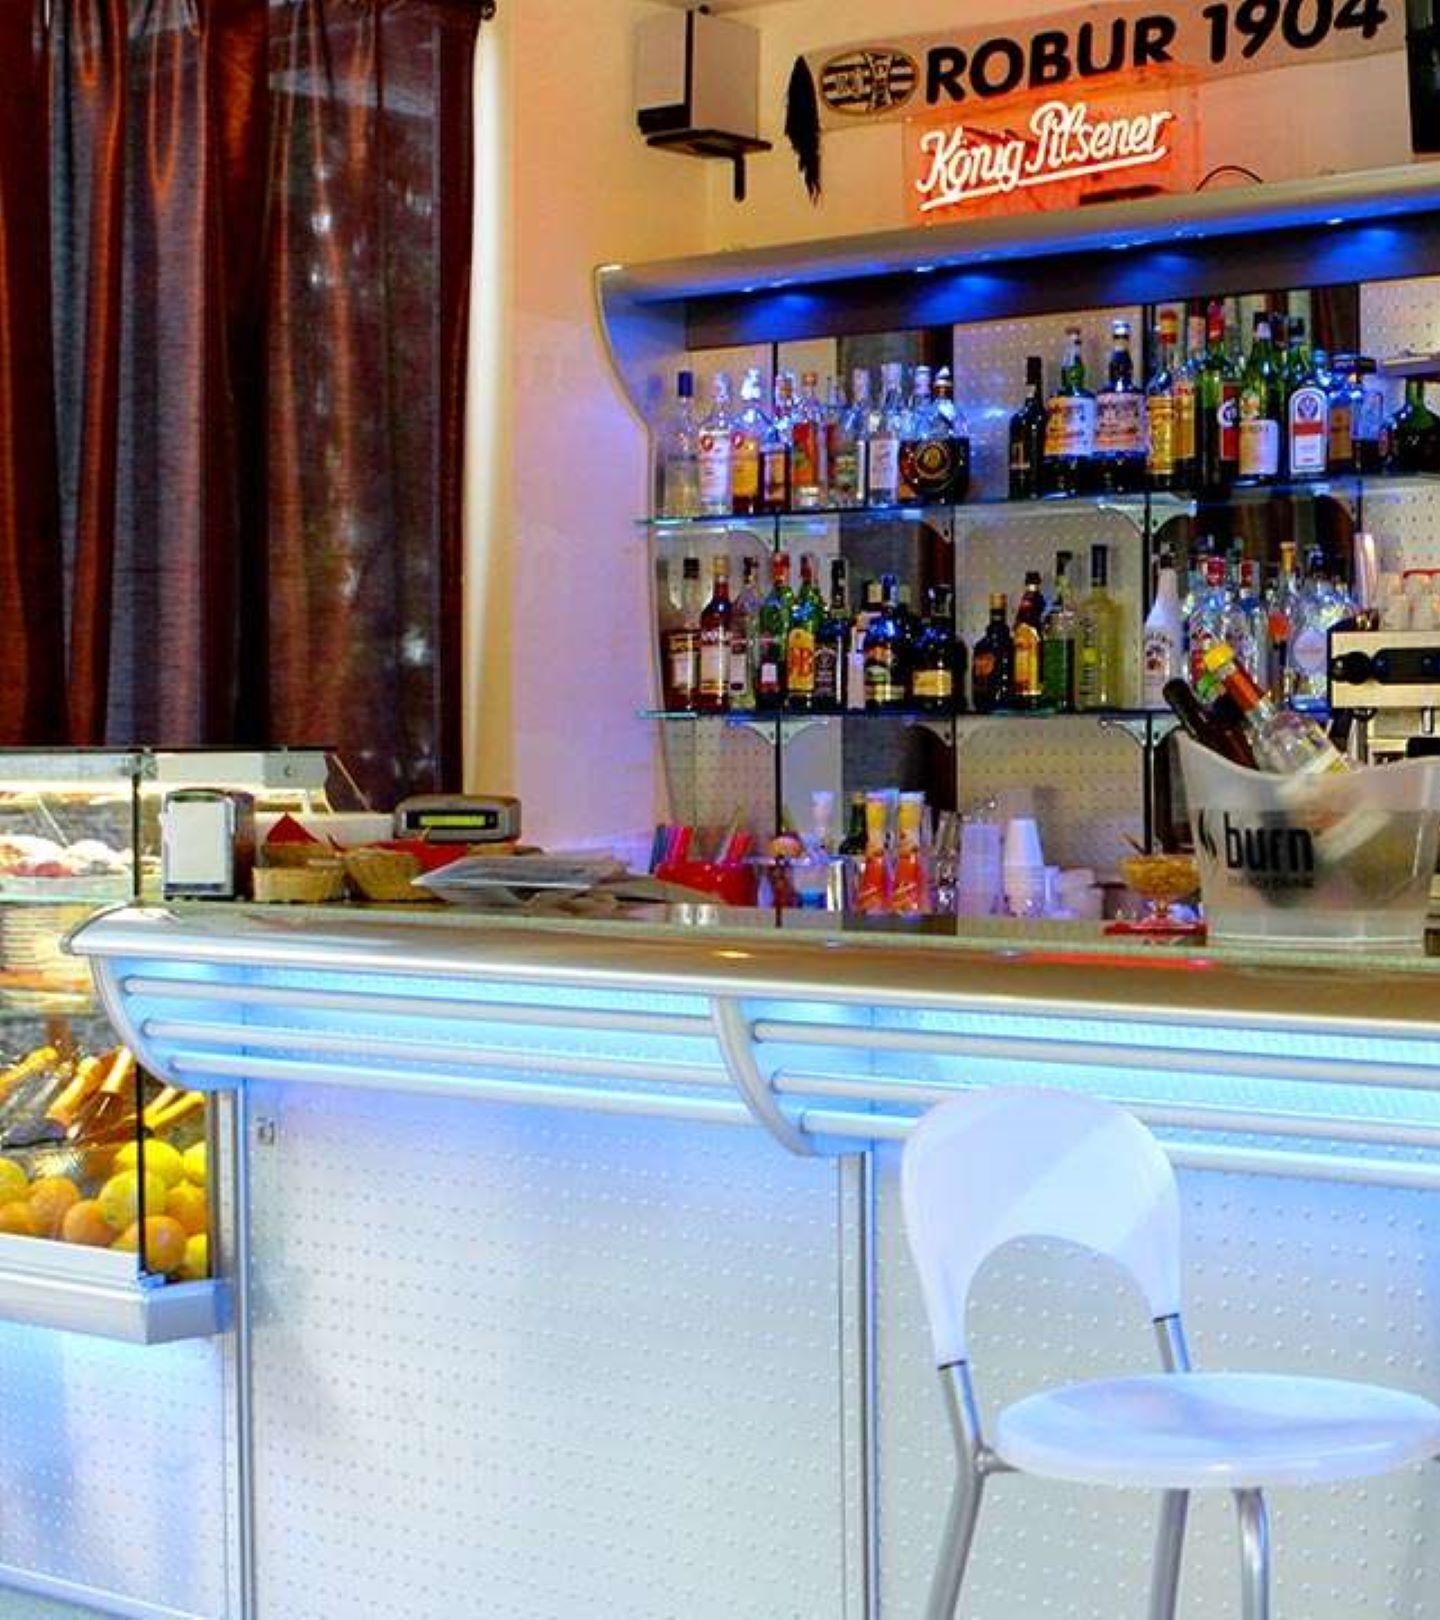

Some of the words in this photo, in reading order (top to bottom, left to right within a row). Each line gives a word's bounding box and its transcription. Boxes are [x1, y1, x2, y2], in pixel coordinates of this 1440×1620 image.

[925, 14, 1178, 104] ROBUR
[1203, 0, 1388, 63] 1904
[1024, 100, 1173, 173] Pilsener
[1223, 811, 1315, 872] burn
